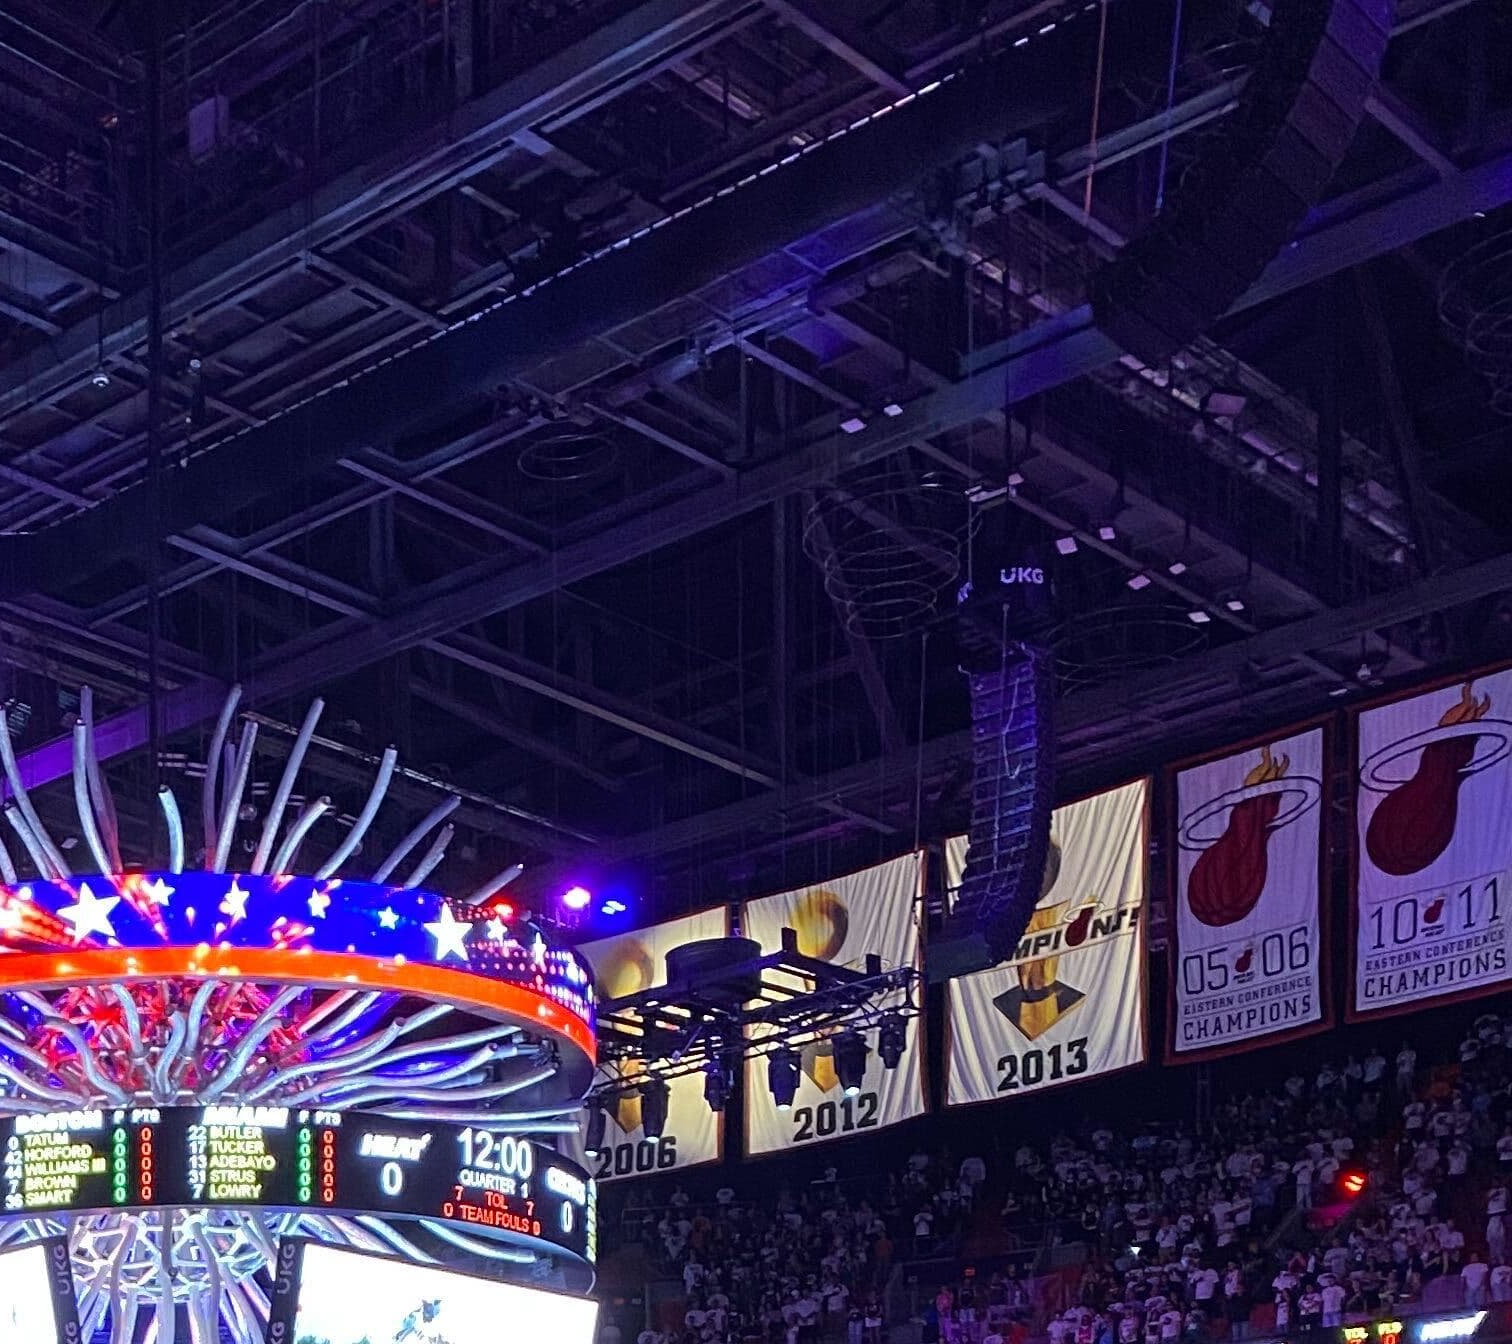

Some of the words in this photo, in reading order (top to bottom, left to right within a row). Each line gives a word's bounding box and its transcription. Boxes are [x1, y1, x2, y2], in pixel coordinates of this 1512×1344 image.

[1000, 567, 1044, 584] UKG
[1370, 898, 1418, 949] 10
[1458, 877, 1500, 929] 11
[1182, 947, 1229, 995] 05
[1262, 926, 1310, 977] 06
[1365, 952, 1421, 972] EASTERN
[1425, 927, 1505, 958] CONFERENCE
[1364, 948, 1507, 998] CHAMPIONS
[1183, 993, 1234, 1016] EASTERN
[1238, 975, 1313, 1004] CONFERENCE
[1183, 994, 1312, 1042] CHAMPIONS
[997, 1037, 1089, 1092] 2013
[131, 1109, 160, 1123] PTS
[315, 1111, 341, 1126] PTS
[794, 1092, 878, 1142] 2012
[7, 1136, 19, 1151] 0
[24, 1132, 69, 1147] TATUM
[114, 1128, 126, 1142] 0
[141, 1128, 152, 1141] 0
[188, 1125, 207, 1140] 22
[209, 1126, 262, 1140] BUTLER
[4, 1150, 22, 1165] 42
[24, 1144, 92, 1161] HORFORD
[189, 1140, 206, 1154] 17
[209, 1140, 265, 1155] TUCKER
[457, 1127, 533, 1179] 12:00
[595, 1136, 677, 1179] 2006
[4, 1165, 22, 1179] 44
[25, 1159, 89, 1176] WILLIAMS
[188, 1170, 206, 1184] 31
[209, 1170, 256, 1183] STRUS
[189, 1155, 207, 1168] 13
[209, 1155, 276, 1171] ADEBAYO
[9, 1180, 19, 1193] 7
[25, 1175, 77, 1191] BROWN
[192, 1185, 204, 1199] 7
[209, 1184, 263, 1199] LOWRY
[382, 1162, 403, 1195] 0
[459, 1168, 516, 1196] QUARTER
[25, 1190, 73, 1206] SMART
[486, 1191, 508, 1210] TOL
[460, 1204, 494, 1226] TEAM
[495, 1212, 530, 1233] FOULS
[562, 1200, 573, 1233] 0
[54, 1244, 72, 1295] UKG
[277, 1243, 295, 1295] UKG
